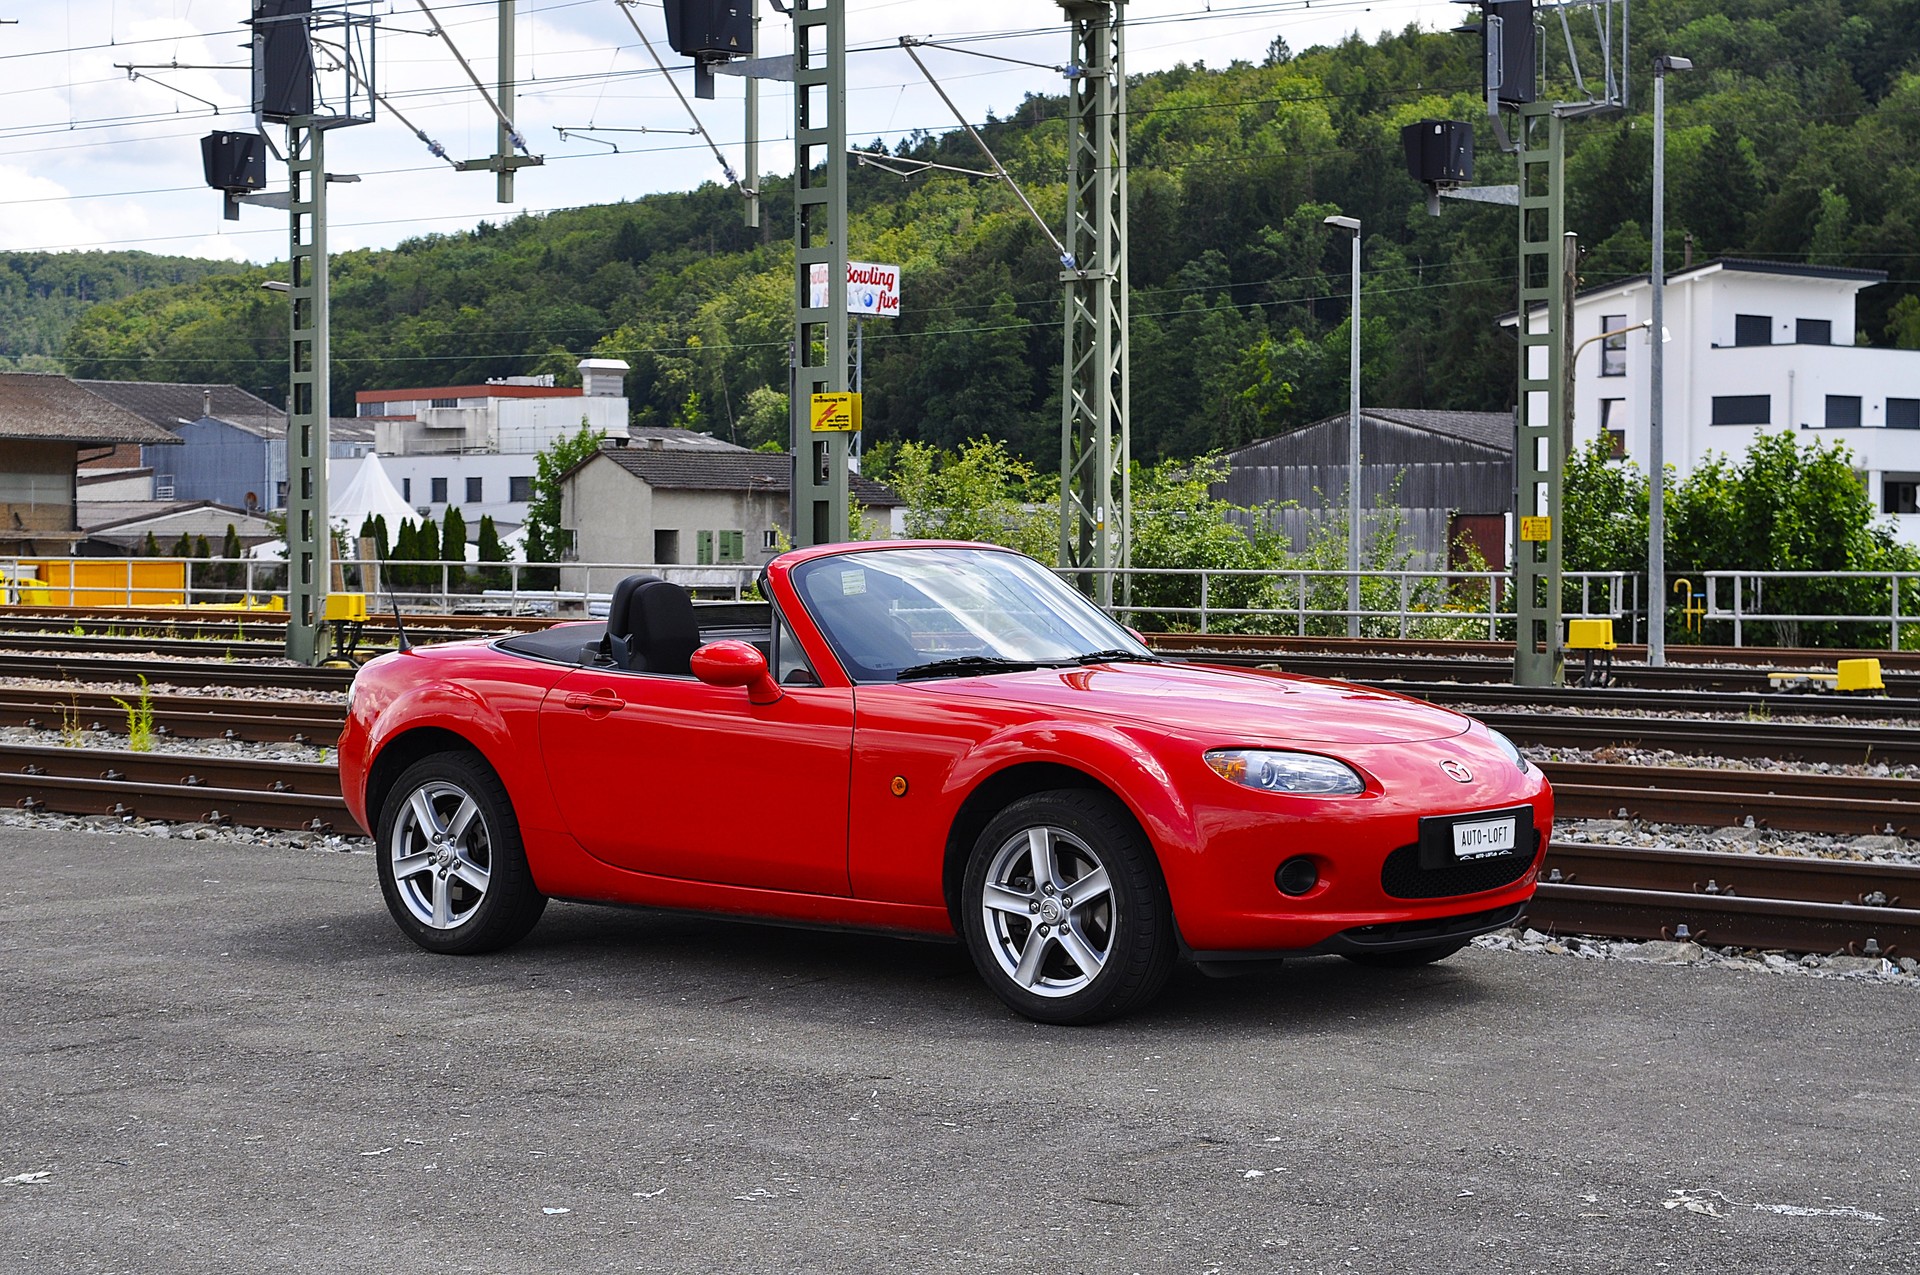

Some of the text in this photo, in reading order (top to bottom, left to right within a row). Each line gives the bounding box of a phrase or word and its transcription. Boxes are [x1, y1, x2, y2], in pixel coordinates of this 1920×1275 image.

[846, 262, 895, 292] Bowling
[876, 290, 898, 313] five
[1461, 826, 1507, 847] AUTO-LOFT
